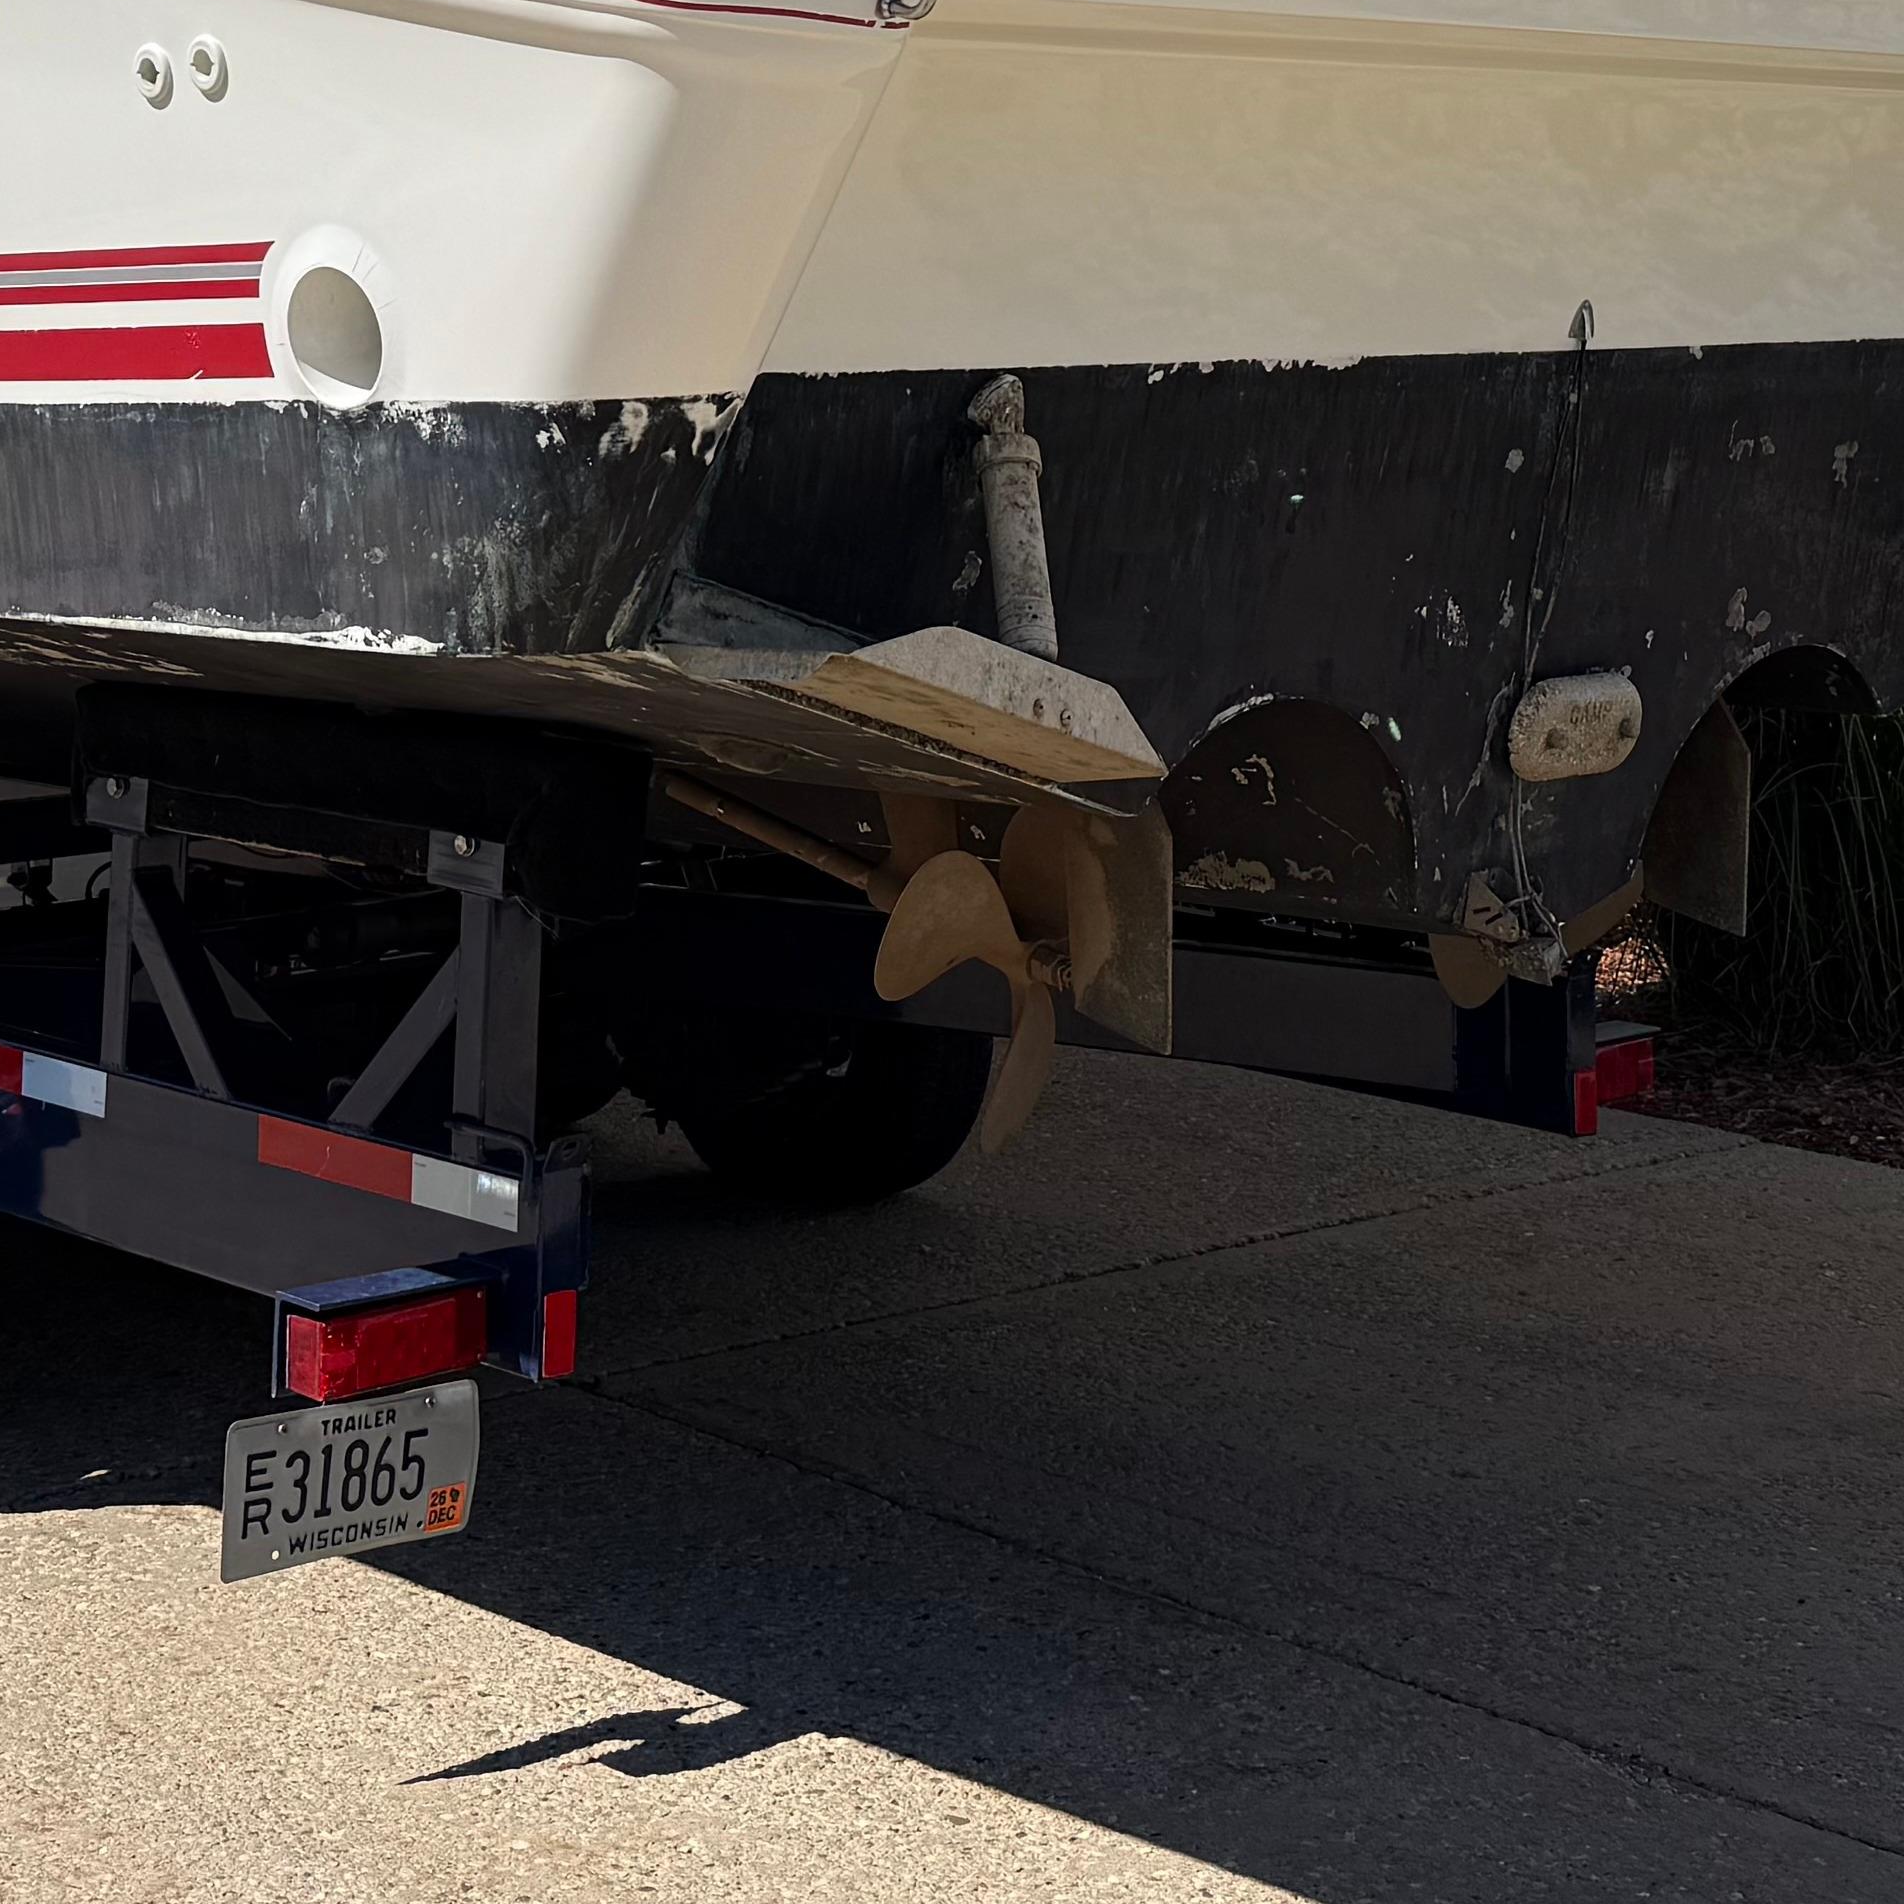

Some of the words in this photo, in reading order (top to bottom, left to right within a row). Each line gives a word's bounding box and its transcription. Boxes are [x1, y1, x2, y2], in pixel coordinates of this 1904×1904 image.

[321, 1408, 397, 1436] TRAILER
[281, 1428, 429, 1524] 31865
[427, 1506, 457, 1526] DEC
[289, 1513, 409, 1556] WISCONSIN
